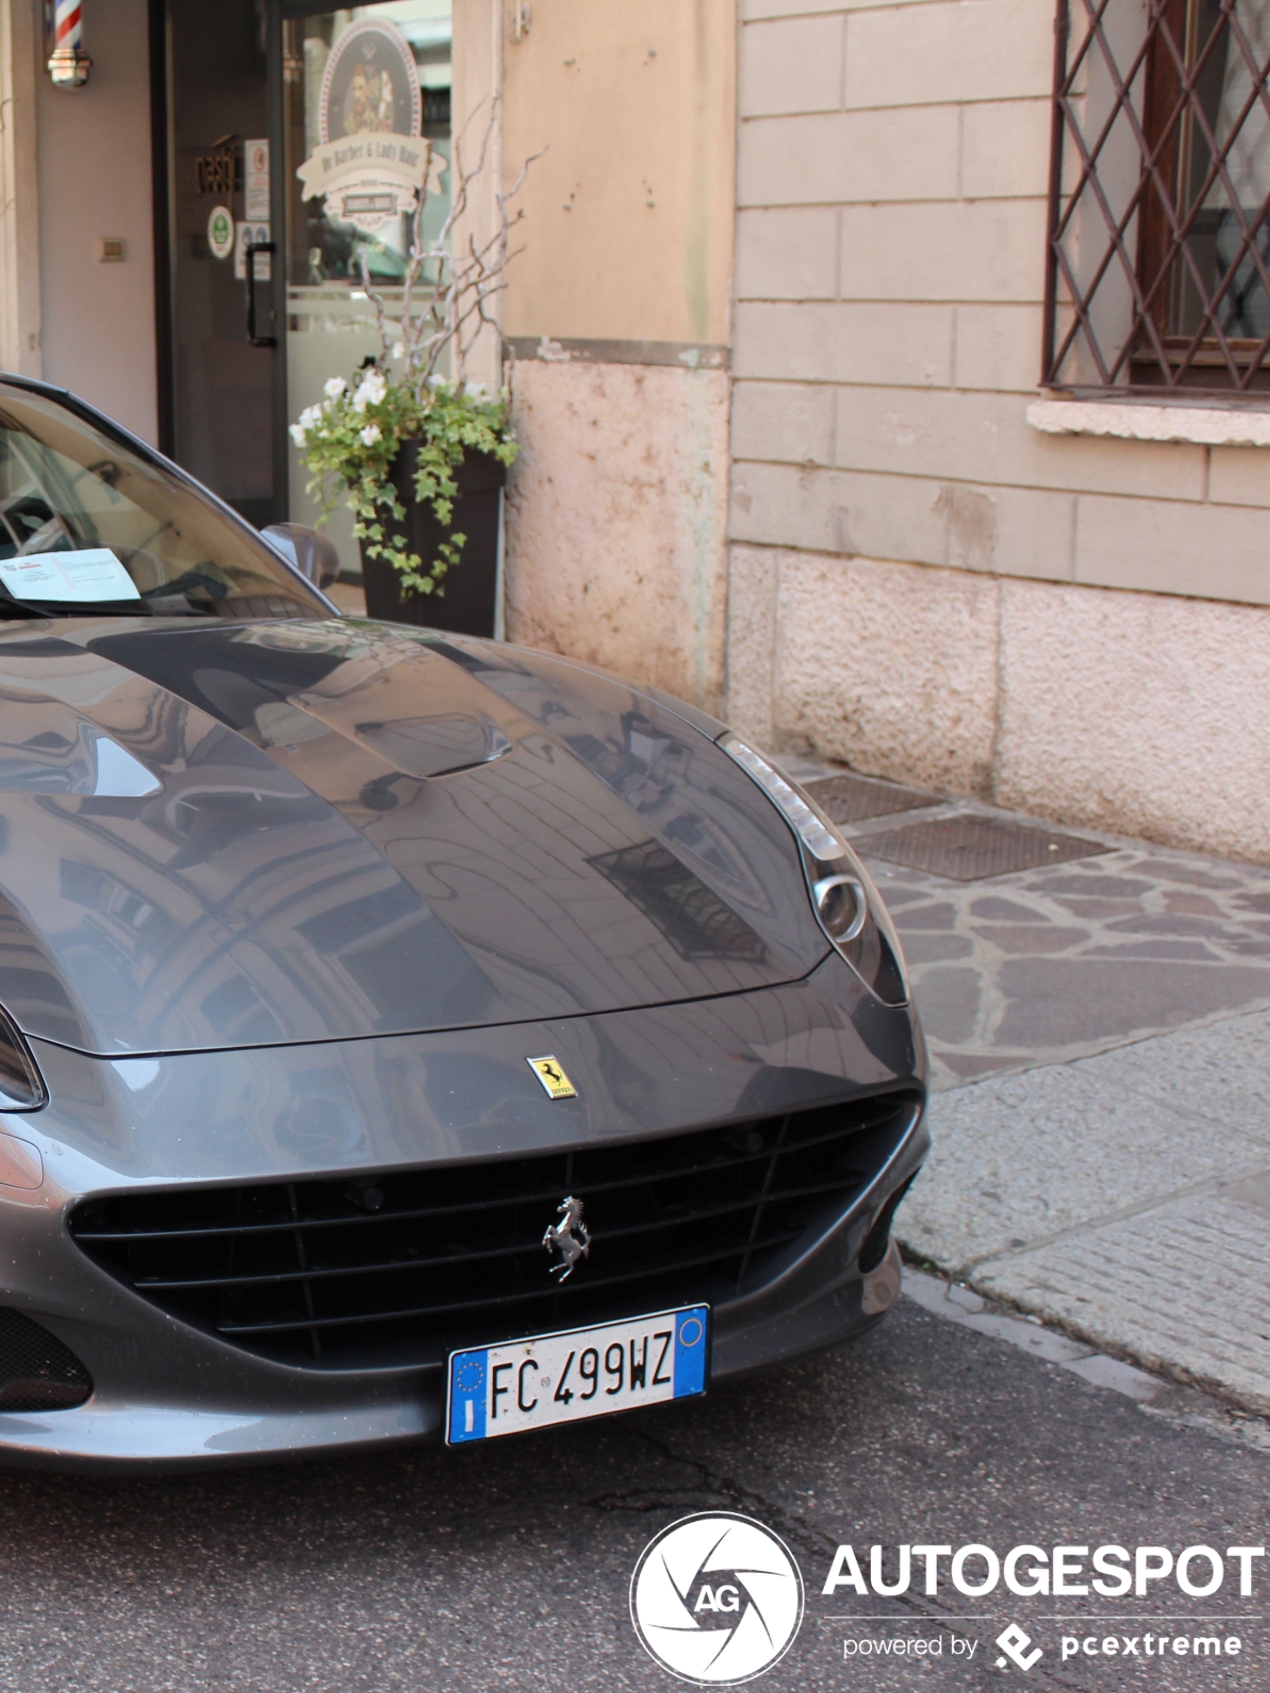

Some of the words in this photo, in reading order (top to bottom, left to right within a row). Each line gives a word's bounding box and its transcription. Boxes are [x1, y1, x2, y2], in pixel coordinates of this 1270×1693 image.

[491, 1359, 539, 1418] FC
[554, 1331, 672, 1405] 499WZ
[464, 1399, 474, 1433] I
